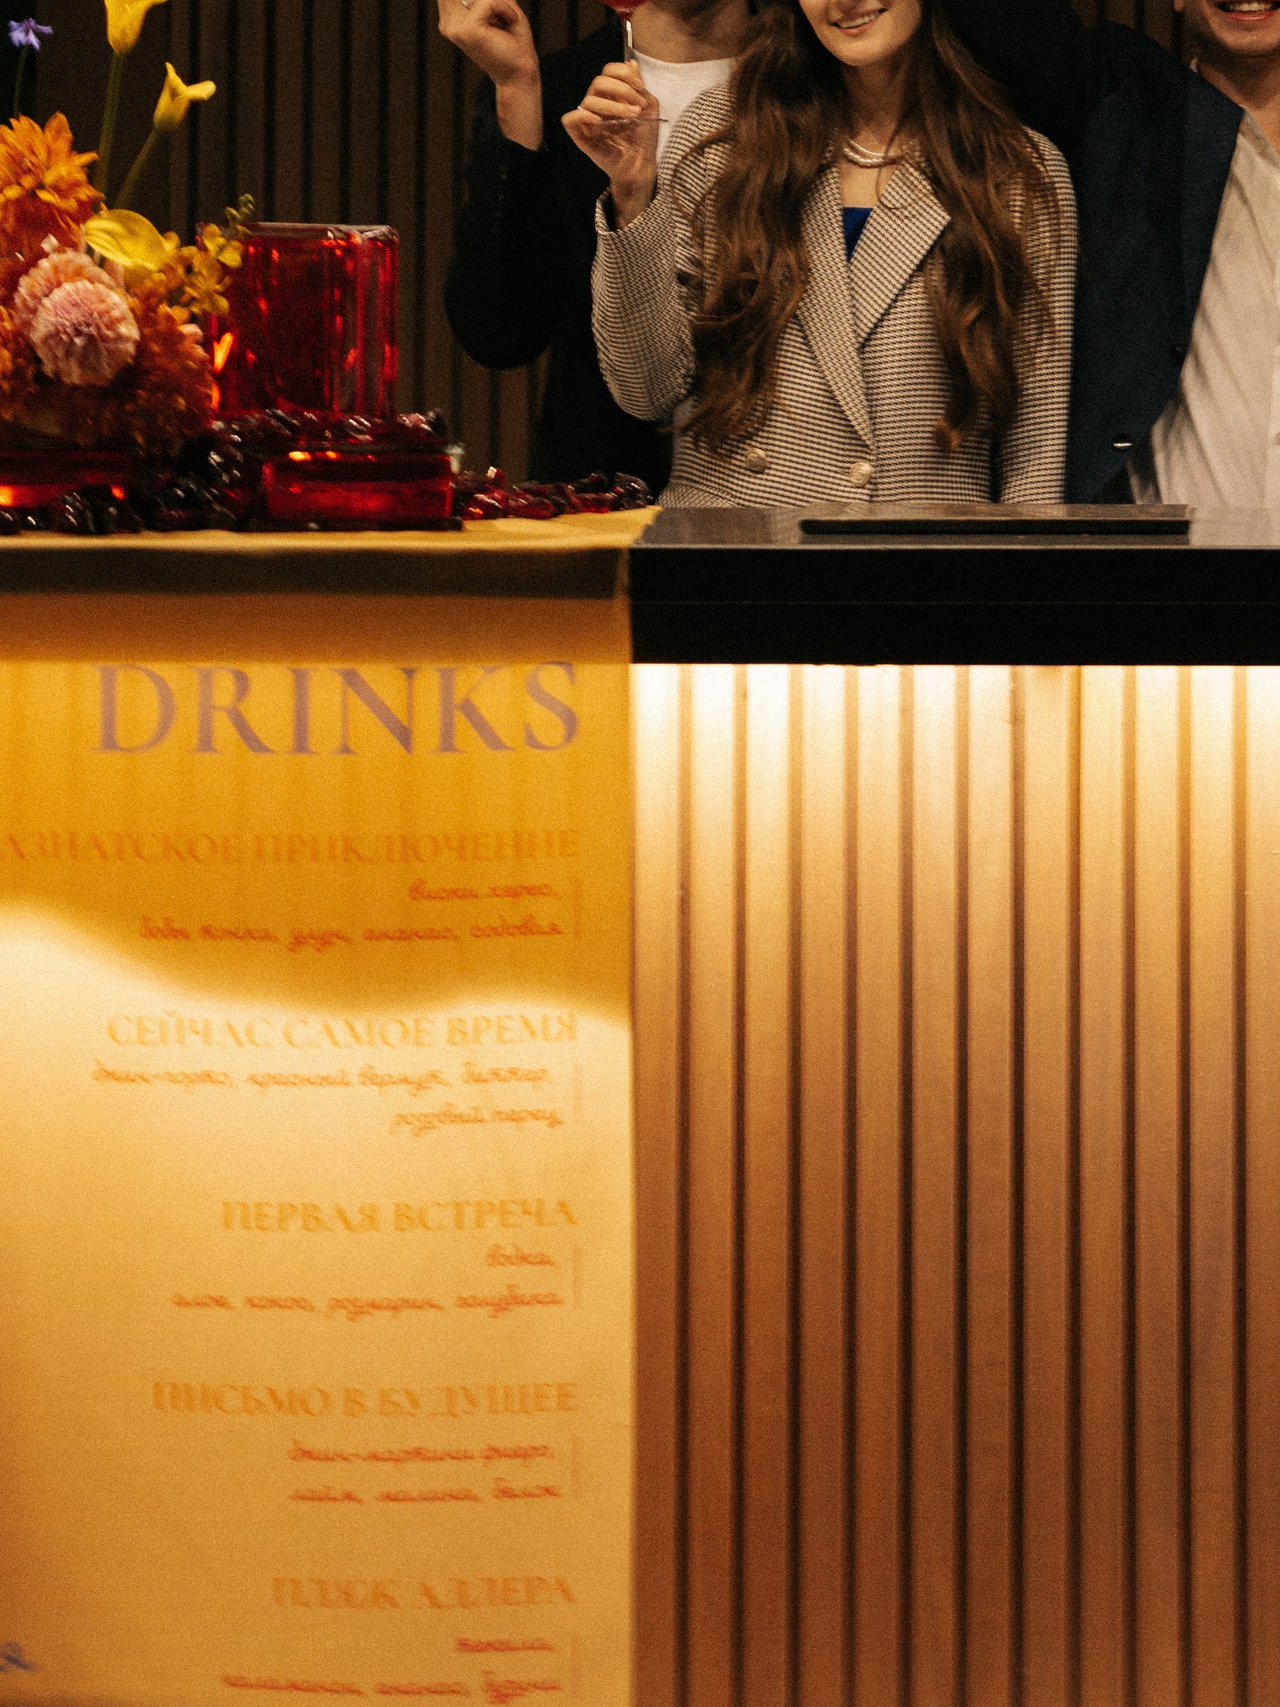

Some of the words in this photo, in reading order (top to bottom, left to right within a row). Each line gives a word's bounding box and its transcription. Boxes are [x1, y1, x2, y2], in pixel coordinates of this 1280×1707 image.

[92, 660, 581, 756] DRINKS
[0, 831, 243, 863] АЗИАТСКОЕ
[253, 829, 584, 864] ПРИКЛЮЧЕНИЕ
[105, 1009, 274, 1049] СЕЙЧАС
[281, 1016, 434, 1050] САМОЕ
[446, 1011, 578, 1046] ВРЕМЯ
[221, 1200, 381, 1233] ПЕРВАЯ
[393, 1197, 579, 1230] ВСТРЕЧА
[152, 1381, 333, 1418] ПИСЬМО
[377, 1381, 580, 1419] БУДУЩЕЕ
